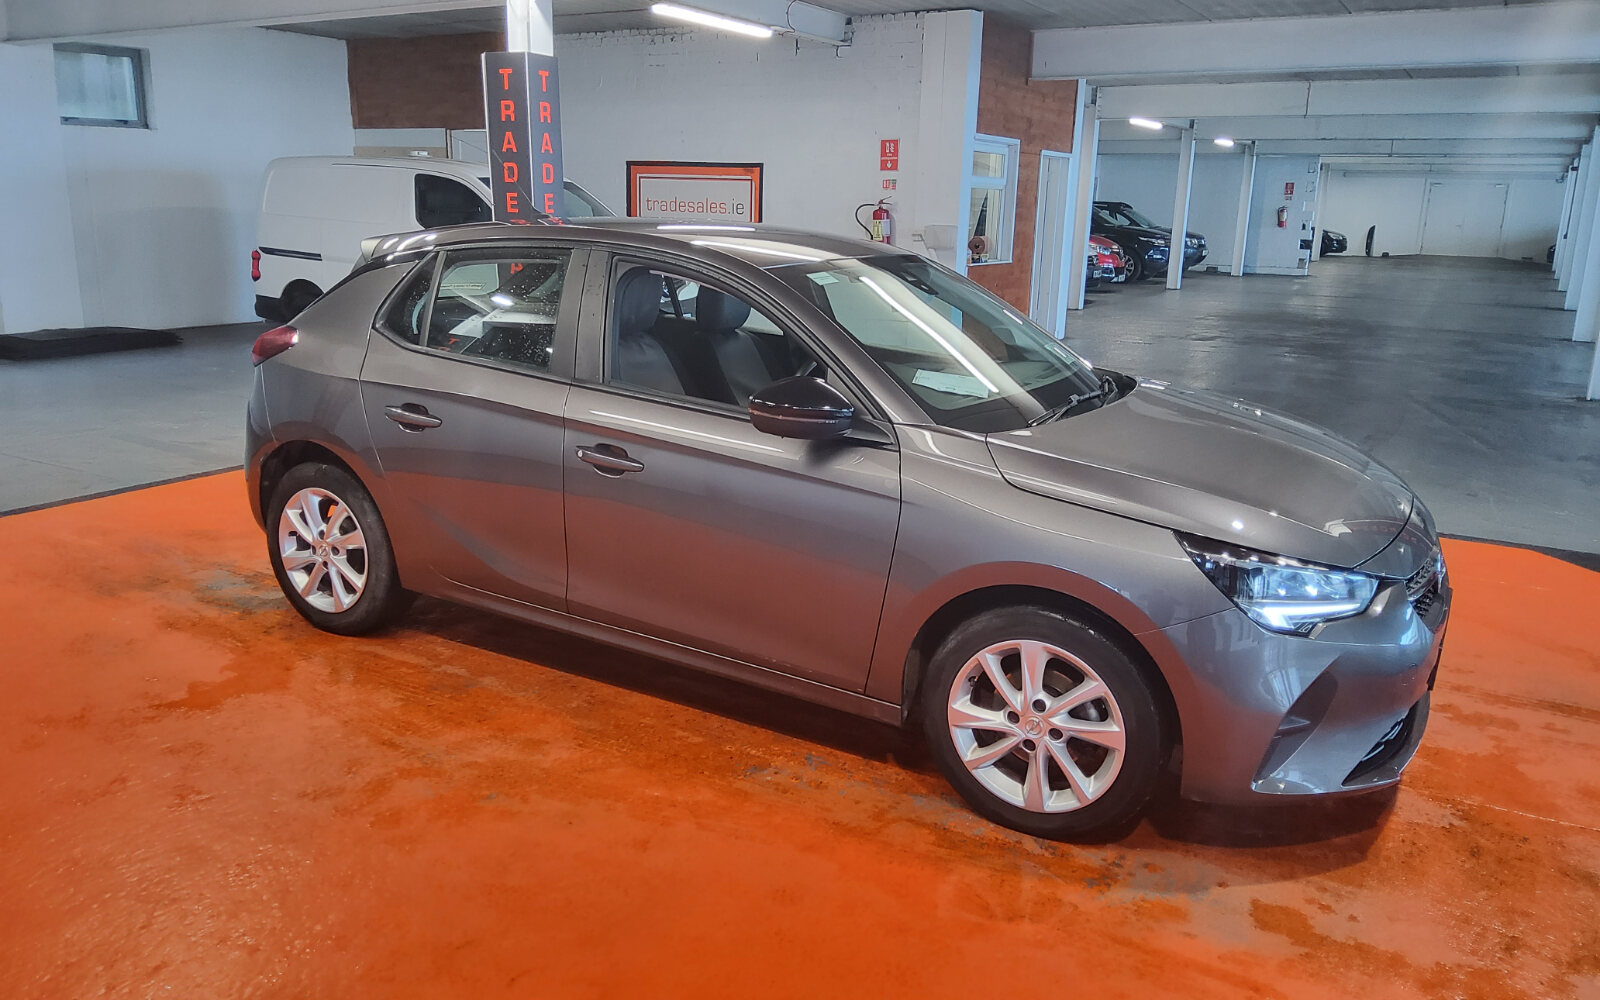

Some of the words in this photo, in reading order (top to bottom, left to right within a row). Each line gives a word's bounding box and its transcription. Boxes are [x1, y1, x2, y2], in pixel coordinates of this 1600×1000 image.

[499, 68, 519, 213] TRADE
[538, 70, 555, 213] TRADE
[646, 196, 745, 215] tradesales.ie
